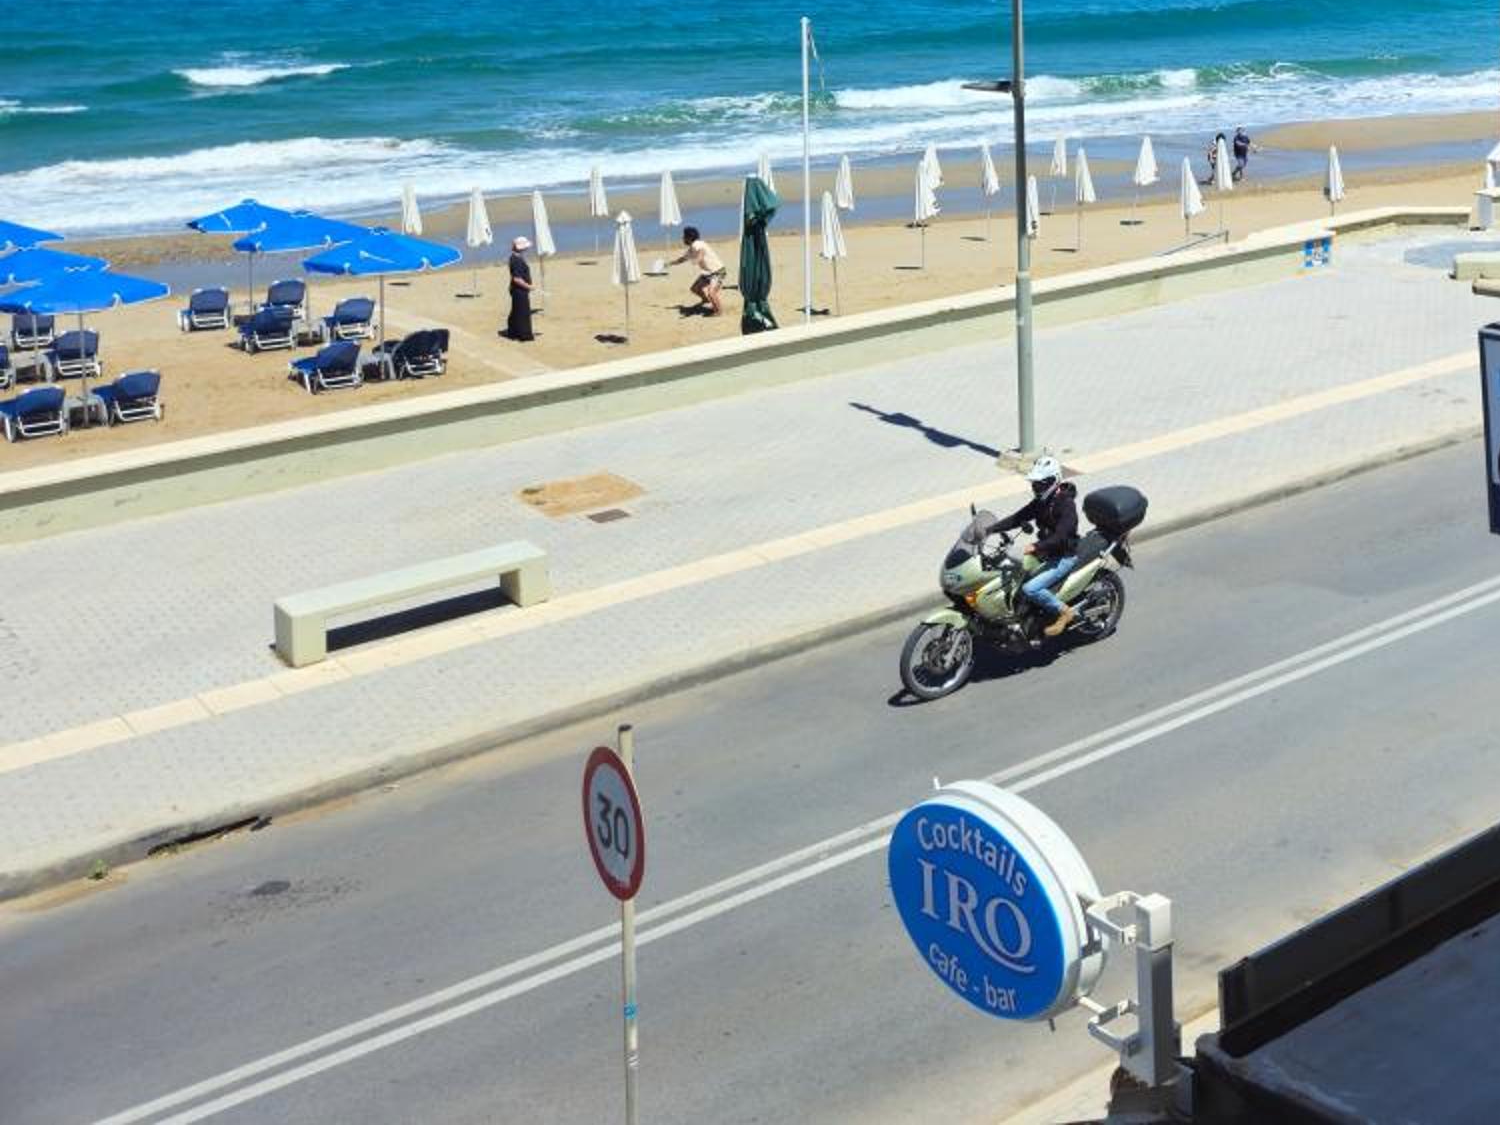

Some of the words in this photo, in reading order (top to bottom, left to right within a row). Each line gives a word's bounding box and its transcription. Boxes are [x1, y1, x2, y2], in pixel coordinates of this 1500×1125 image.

[597, 792, 630, 862] 30
[916, 816, 1029, 897] Cocktails
[917, 858, 1037, 973] IRO
[983, 976, 1017, 1013] bar
